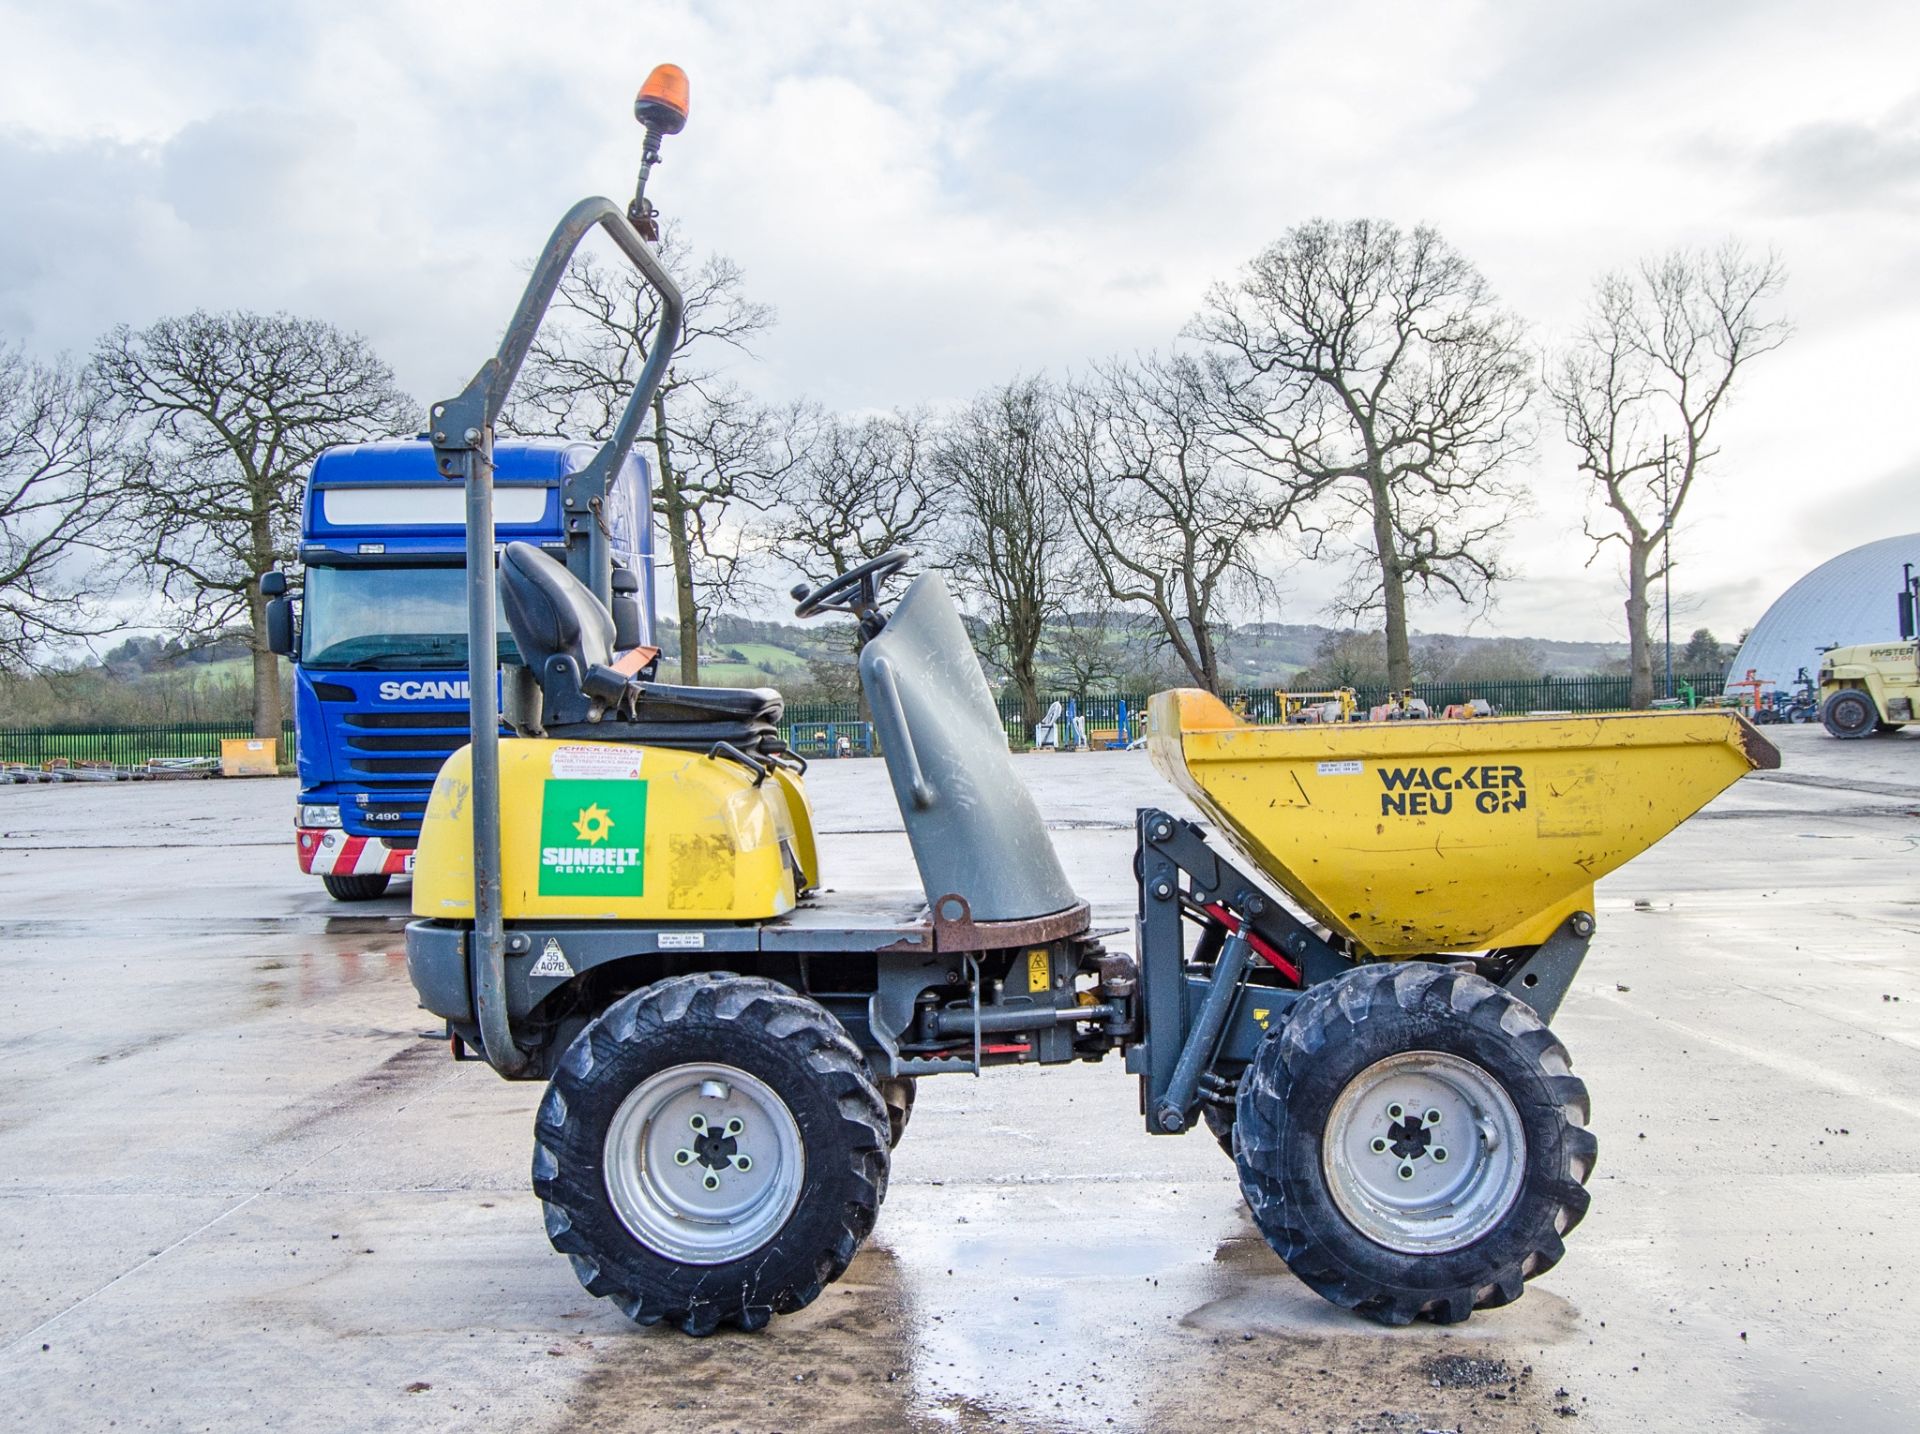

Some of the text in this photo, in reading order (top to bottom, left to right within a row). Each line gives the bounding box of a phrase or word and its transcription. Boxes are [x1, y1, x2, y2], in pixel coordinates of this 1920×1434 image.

[1870, 647, 1914, 657] HYSTER
[379, 681, 471, 700] SCANI
[1376, 765, 1527, 790] WACKER
[366, 813, 400, 821] R 490
[542, 847, 640, 866] SUNBELT
[555, 865, 625, 874] RENTALS
[540, 961, 565, 971] A07B
